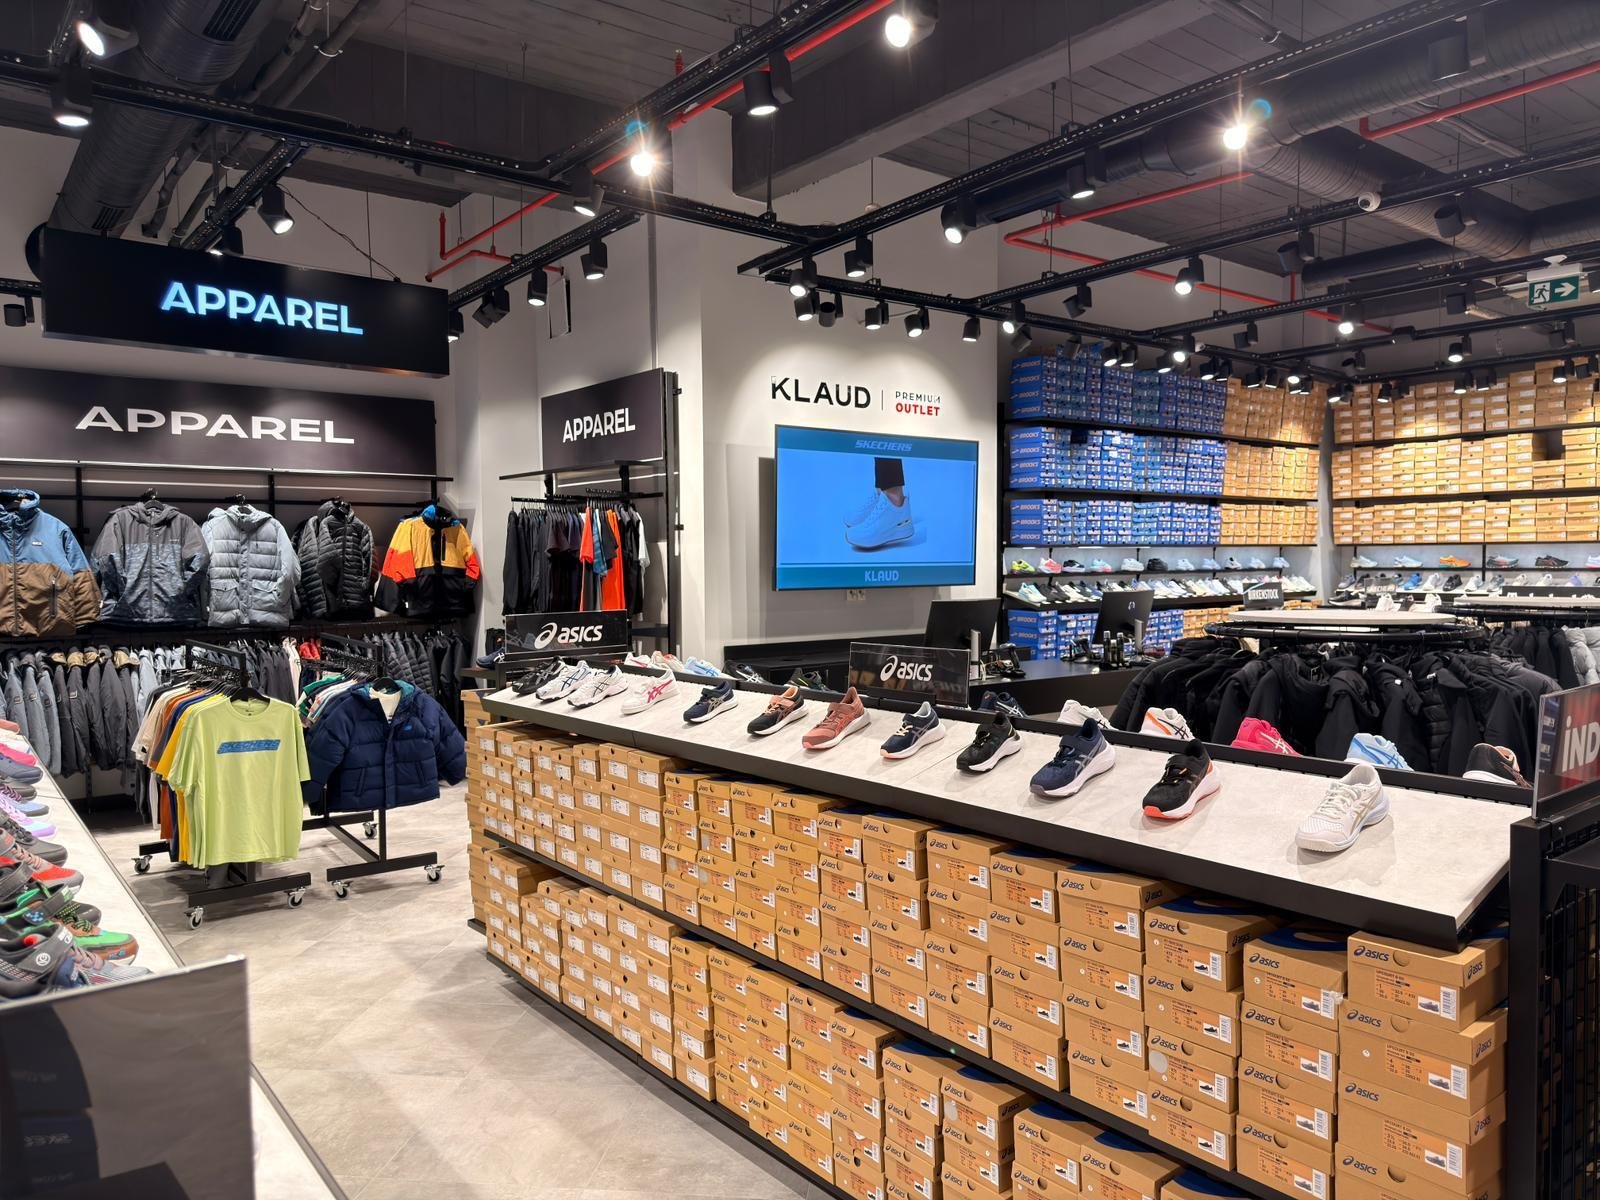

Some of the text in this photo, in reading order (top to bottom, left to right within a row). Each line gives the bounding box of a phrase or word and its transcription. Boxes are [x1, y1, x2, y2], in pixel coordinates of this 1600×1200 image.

[160, 281, 364, 335] APPAREL
[772, 377, 871, 408] KLAUD
[896, 402, 940, 416] OUTLET
[76, 405, 355, 444] APPAREL
[563, 407, 636, 444] APPAREL
[855, 440, 912, 452] SKECHERS
[864, 570, 899, 582] KLAUD
[558, 624, 603, 644] asics
[897, 662, 933, 681] asics
[1068, 881, 1084, 890] asics
[1157, 921, 1175, 932] asics
[1071, 938, 1087, 950] asics
[1365, 949, 1389, 961] asics
[1259, 957, 1280, 968] asics
[1156, 980, 1174, 990] asics
[1074, 998, 1089, 1007] asics
[1255, 1014, 1275, 1025] asics
[1358, 1015, 1381, 1028] asics
[1160, 1039, 1177, 1051] asics
[1079, 1053, 1095, 1064] asics
[1254, 1071, 1273, 1083] asics
[1160, 1095, 1177, 1106] asics
[1356, 1089, 1379, 1101] asics
[1252, 1130, 1272, 1142] asics
[1090, 1157, 1106, 1169] asics
[1354, 1163, 1377, 1175] asics
